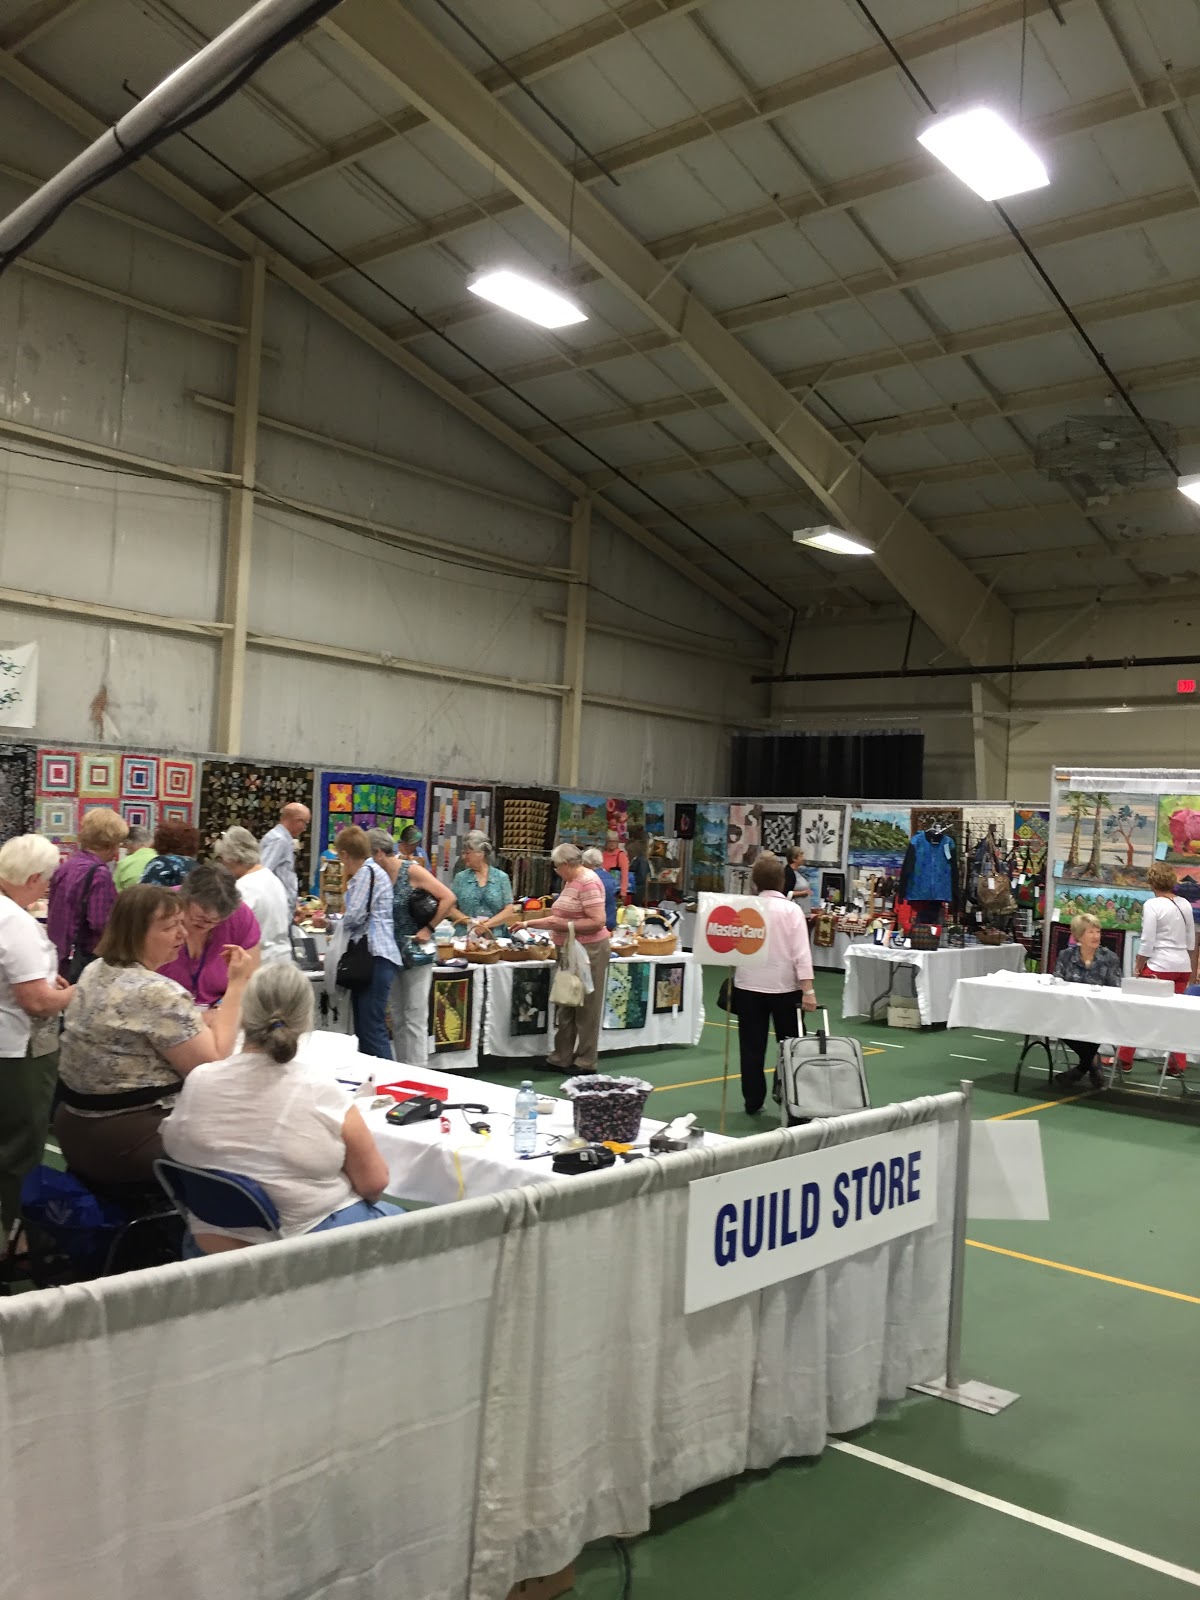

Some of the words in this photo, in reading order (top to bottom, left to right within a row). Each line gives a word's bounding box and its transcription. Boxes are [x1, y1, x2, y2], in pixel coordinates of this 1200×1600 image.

[706, 922, 766, 939] MasterCard
[714, 1182, 820, 1267] GUILD
[832, 1151, 922, 1228] STORE
